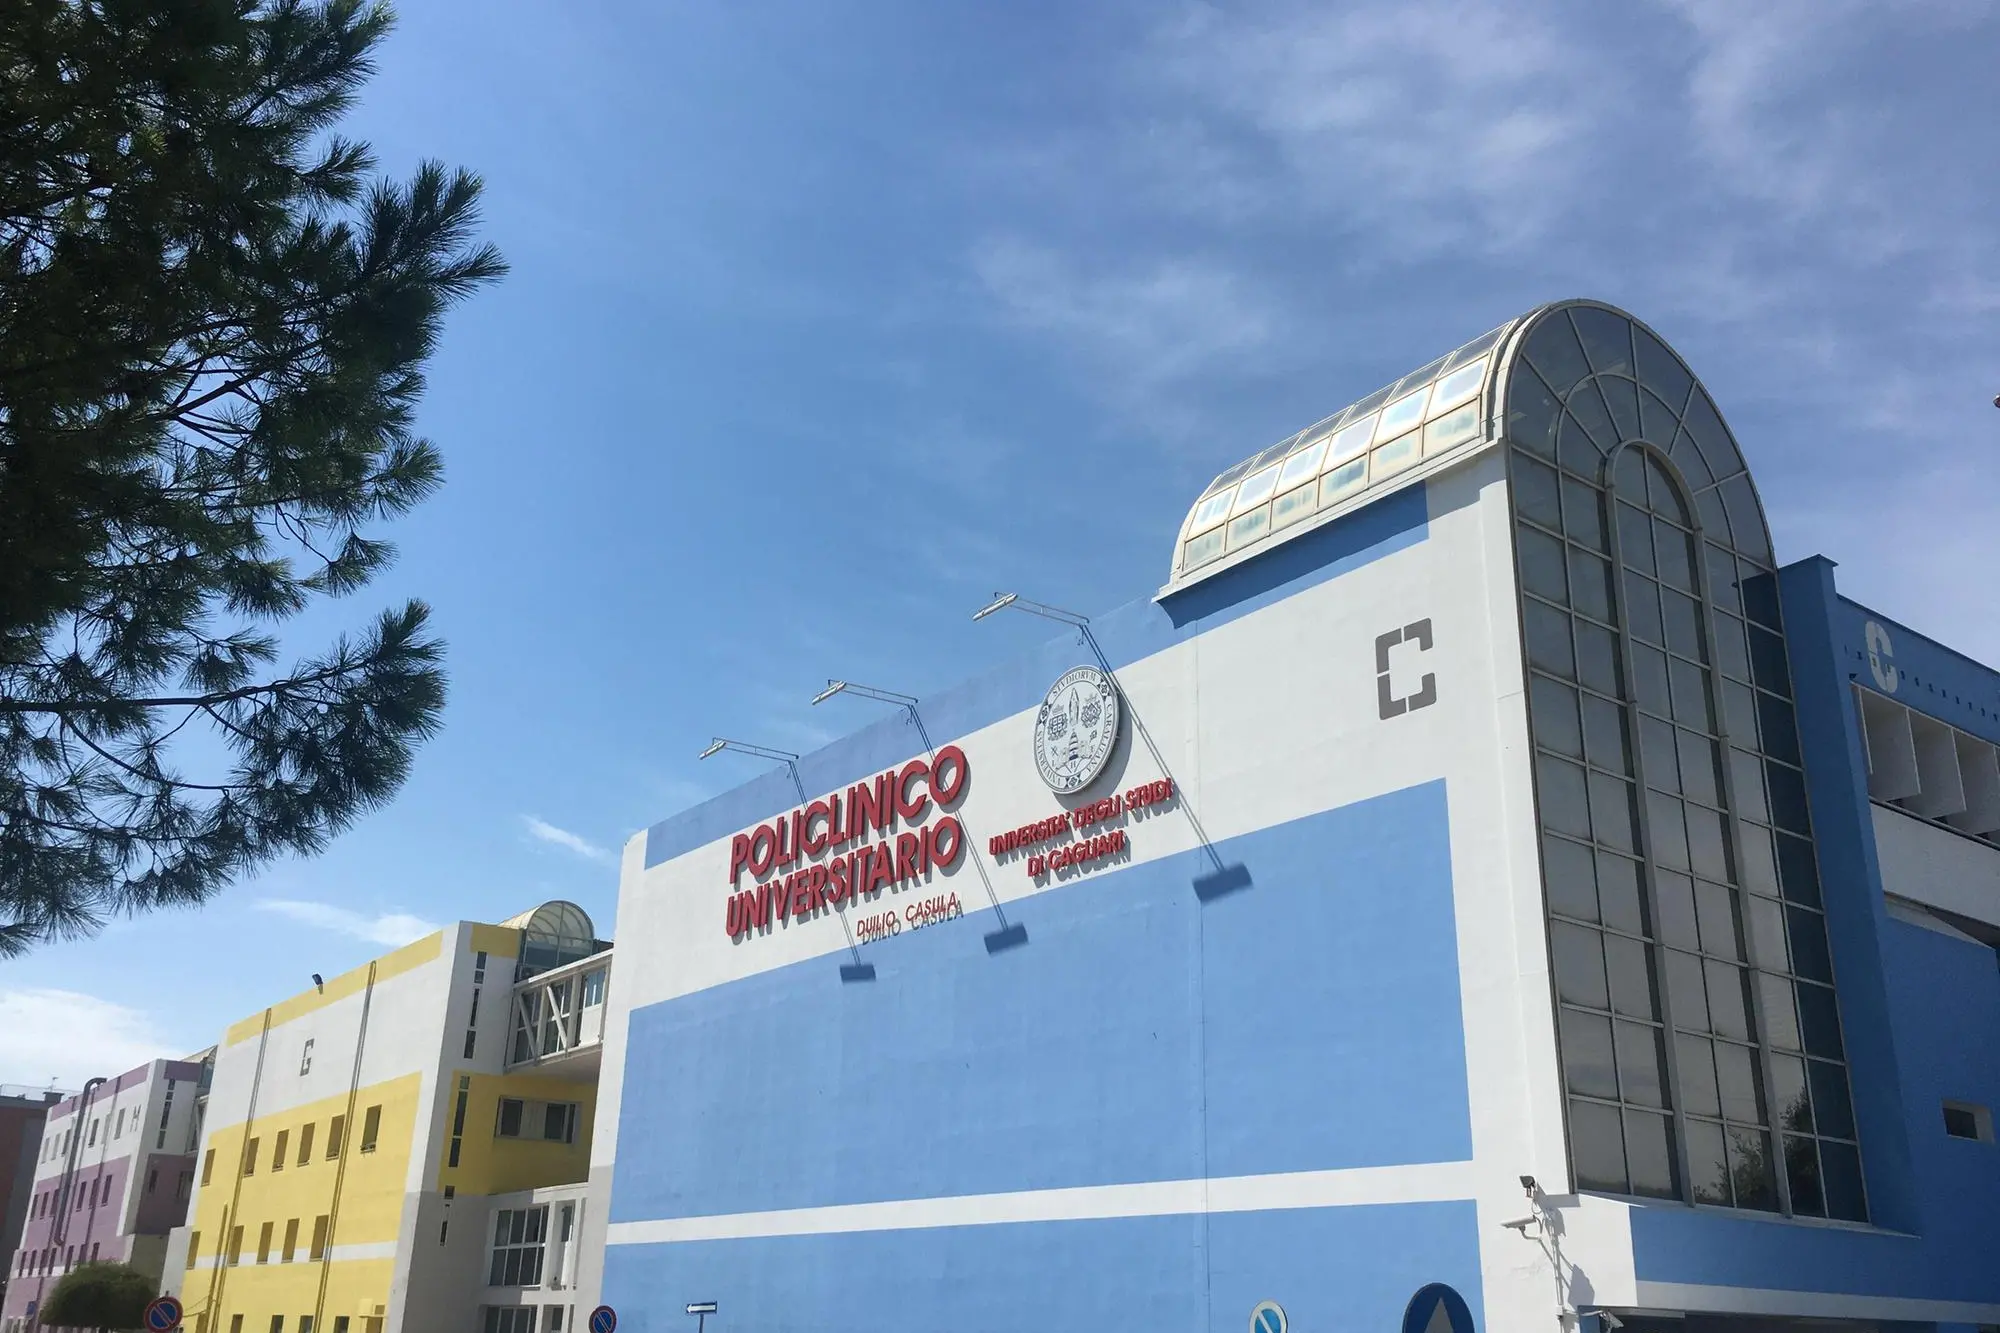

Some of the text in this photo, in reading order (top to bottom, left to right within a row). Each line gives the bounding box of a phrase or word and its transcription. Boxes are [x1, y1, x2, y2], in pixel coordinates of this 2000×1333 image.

[1375, 617, 1437, 721] C
[729, 745, 967, 884] POLICLINICO
[1074, 795, 1121, 828] DEGLI
[1125, 777, 1174, 811] STUDI
[726, 816, 961, 937] UNIVERSITARIO
[1028, 830, 1127, 878] DI CAGLIARI
[857, 891, 958, 937] DUILIO CASULA
